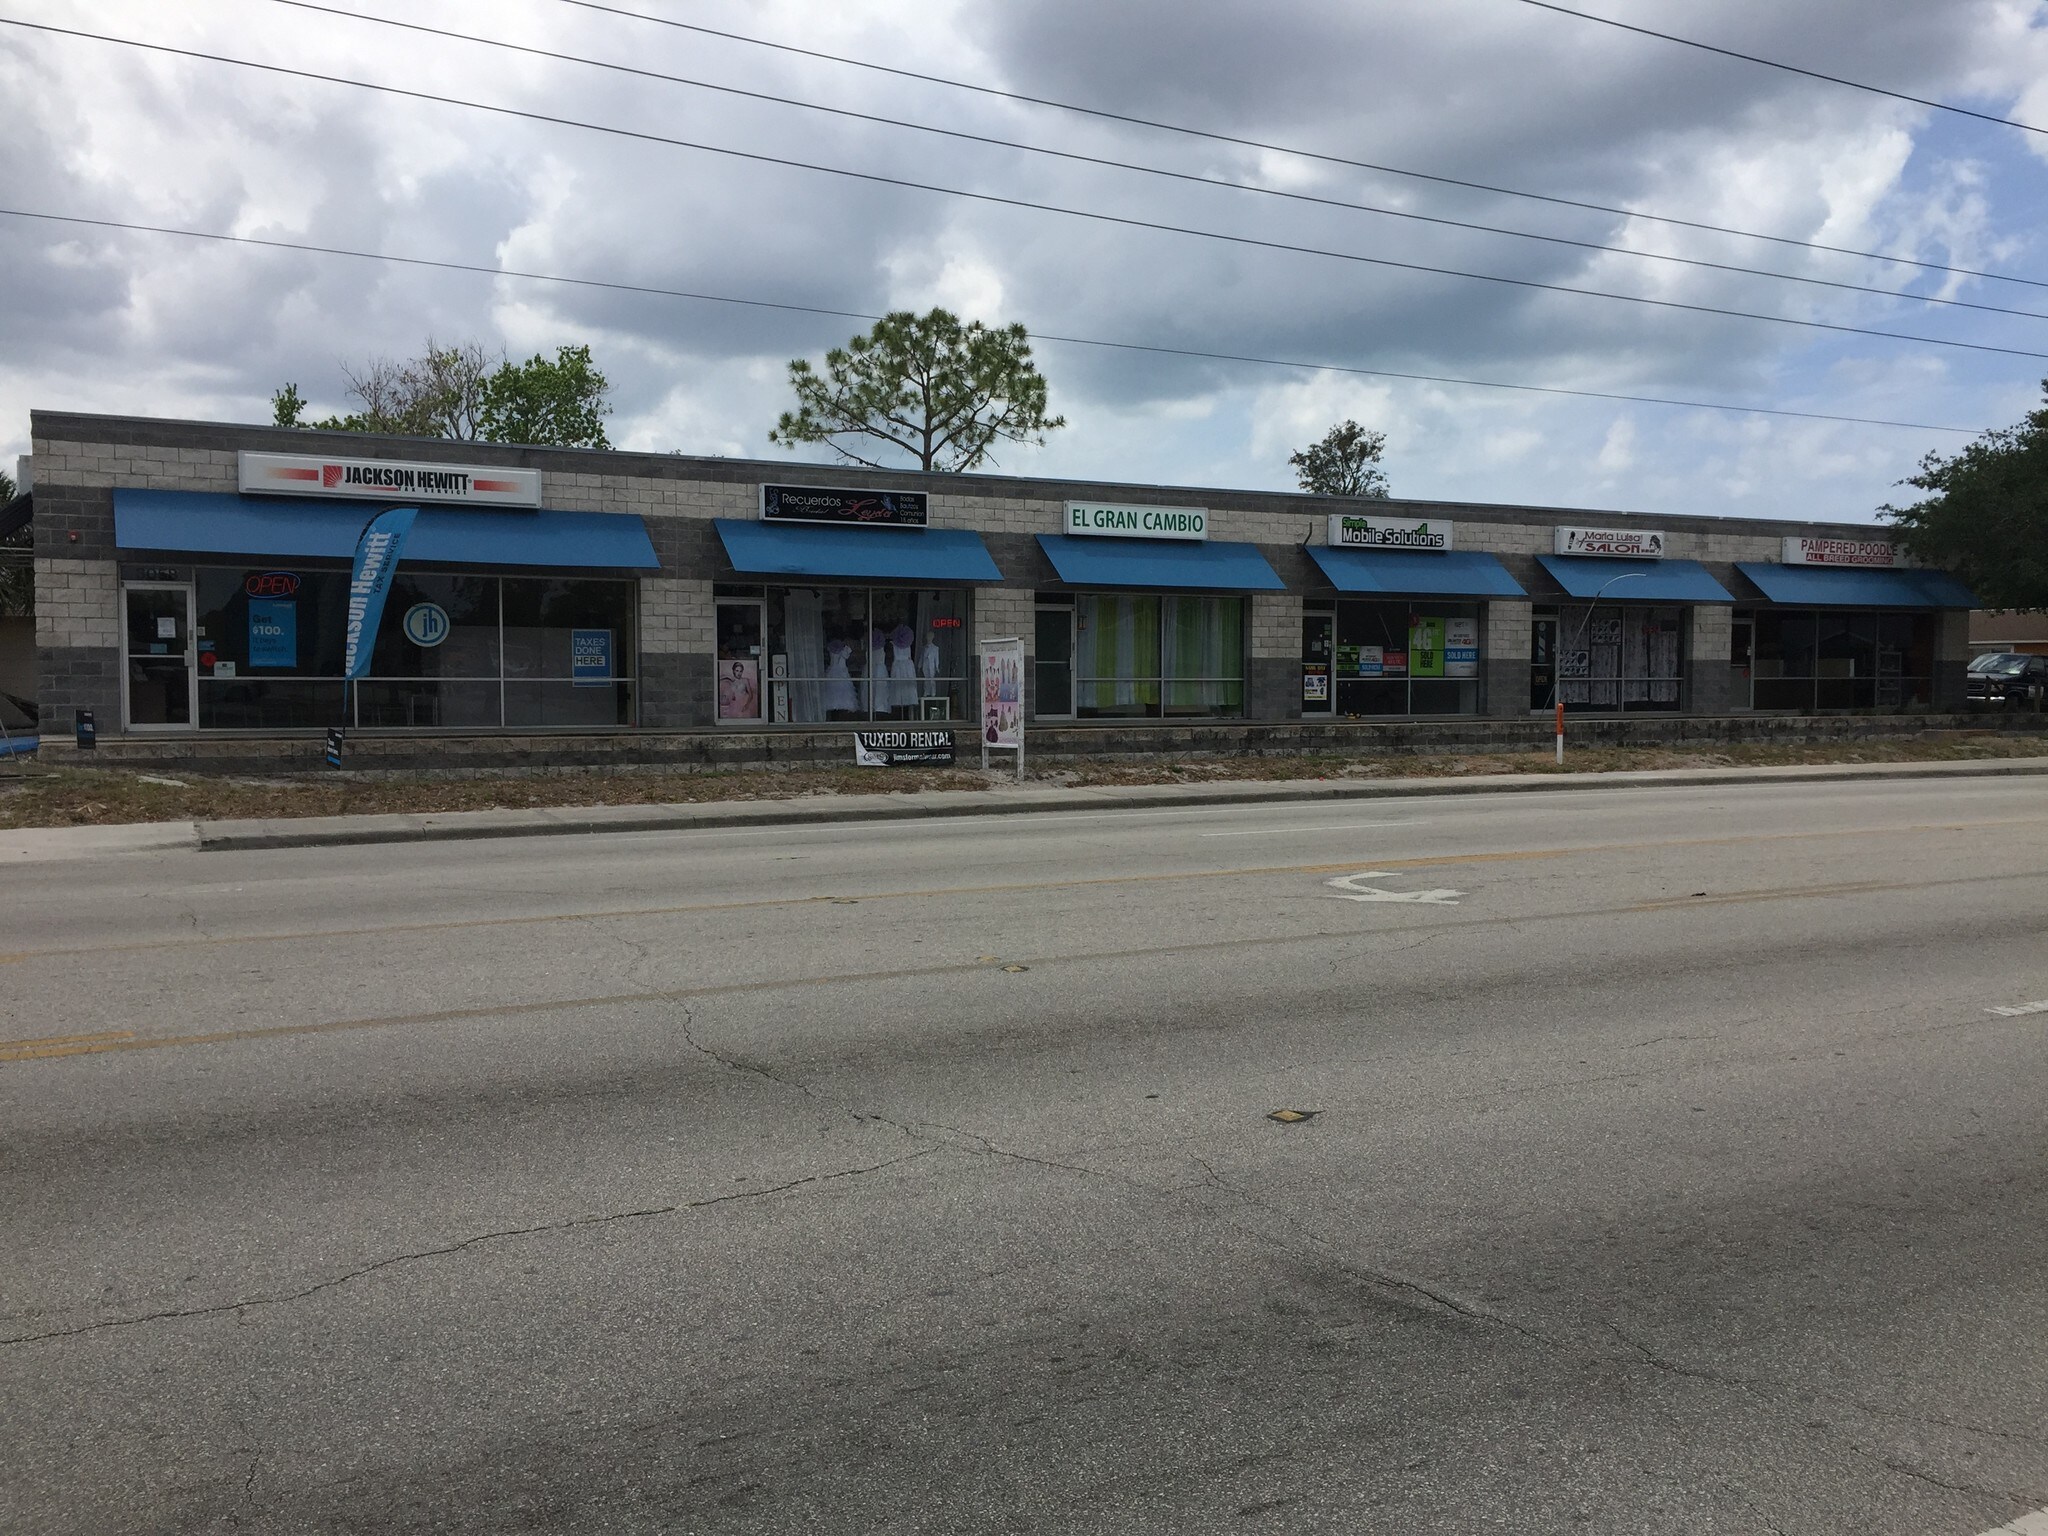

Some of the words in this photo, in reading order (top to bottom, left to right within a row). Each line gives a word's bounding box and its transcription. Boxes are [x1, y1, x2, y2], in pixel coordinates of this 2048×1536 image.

[345, 466, 415, 488] JACKSON
[417, 471, 469, 490] HEWITT
[424, 487, 467, 495] SERVICE
[782, 493, 841, 507] Recuerdos
[1072, 509, 1090, 527] EL
[1094, 510, 1137, 529] GRAN
[1143, 512, 1203, 533] CAMBIO
[1342, 517, 1367, 528] Simple
[1342, 527, 1383, 543] Mobile
[1385, 528, 1444, 547] Solutions
[1585, 531, 1613, 541] Maria
[1616, 532, 1641, 542] Luisa
[1585, 543, 1640, 553] SALON
[1801, 540, 1856, 554] PAMPERED
[1859, 543, 1898, 556] POODLE
[350, 532, 391, 594] Hewitt
[1806, 553, 1822, 561] ALL
[1824, 554, 1852, 563] BREED
[1852, 556, 1893, 564] GROOMING
[373, 575, 386, 598] TAX
[380, 533, 401, 573] SERVICE
[246, 575, 297, 594] OPEN
[252, 614, 272, 624] Get
[422, 608, 438, 638] jh
[932, 618, 961, 627] OPEN
[252, 625, 285, 636] $100.
[575, 638, 606, 646] TAXES
[1413, 628, 1432, 649] 4G
[575, 646, 602, 655] DONE
[1420, 651, 1433, 660] SOLD
[1447, 651, 1461, 659] SOLD
[1462, 651, 1476, 659] HERE
[576, 656, 604, 665] HERE
[1420, 660, 1433, 668] HERE
[861, 732, 907, 748] TUXEDO
[910, 732, 951, 747] RENTAL
